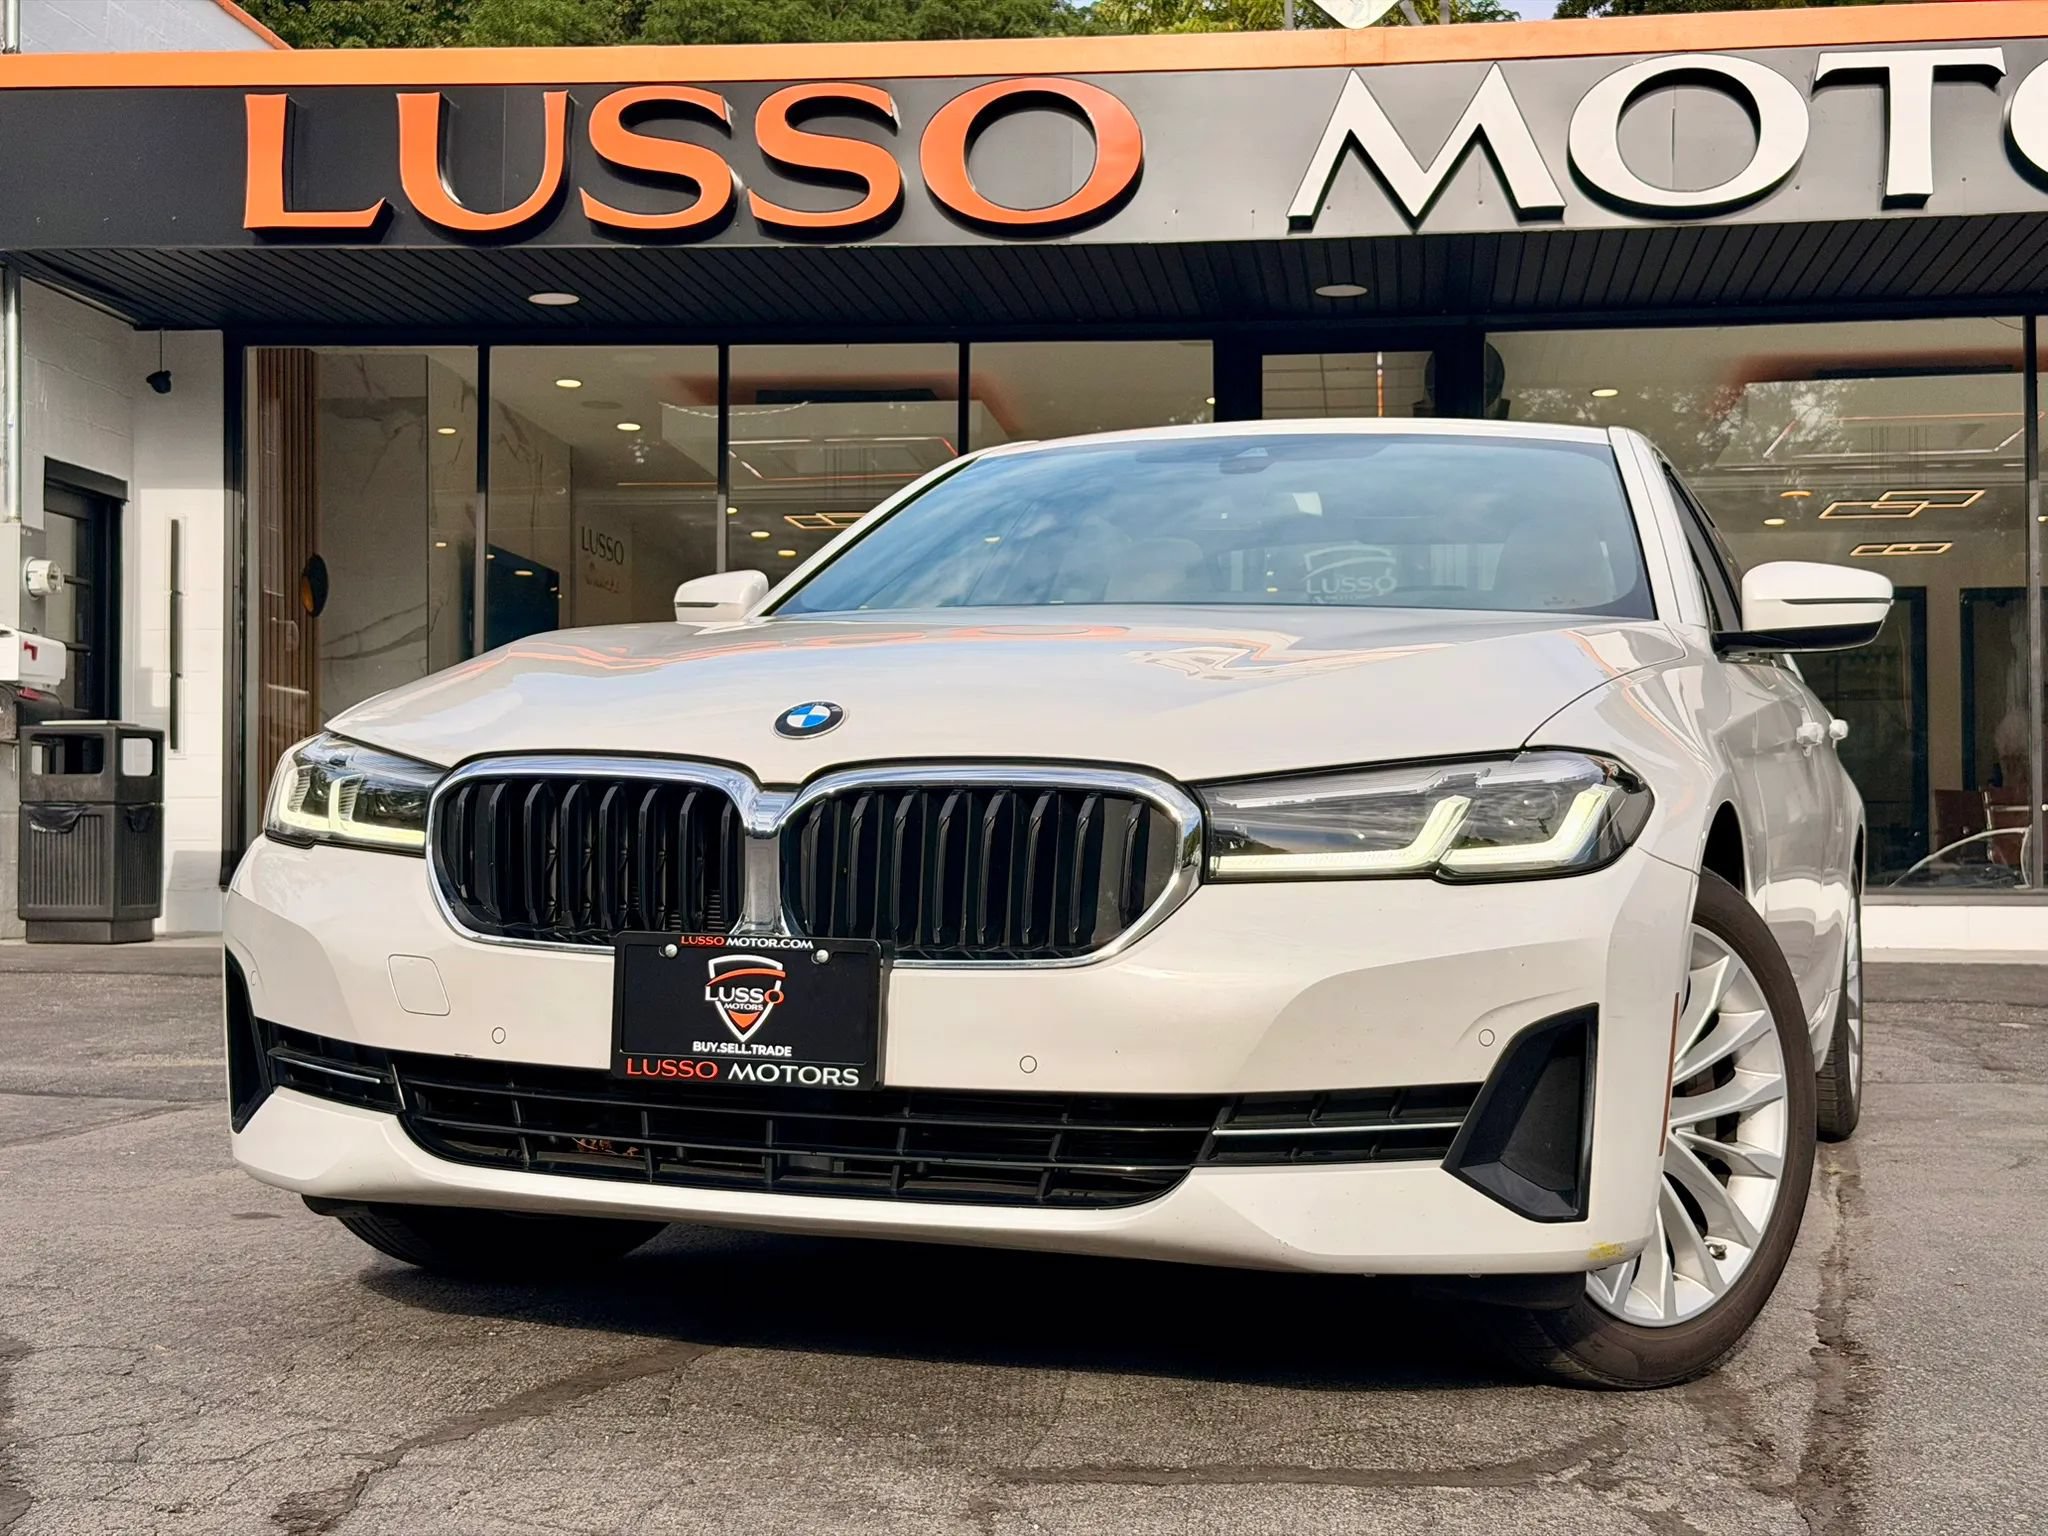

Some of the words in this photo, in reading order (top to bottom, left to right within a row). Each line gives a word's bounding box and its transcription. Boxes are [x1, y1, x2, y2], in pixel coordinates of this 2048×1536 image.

[243, 76, 1144, 235] LUSSO
[1286, 47, 2048, 234] MOT
[581, 526, 625, 566] LUSSO
[1306, 576, 1397, 594] LUSSO
[705, 986, 785, 1004] LUSSO
[724, 1003, 764, 1011] MOTORS
[692, 1041, 792, 1057] BUY.SELL.TRADE
[626, 1058, 718, 1080] LUSSO
[728, 1063, 860, 1087] MOTORS
